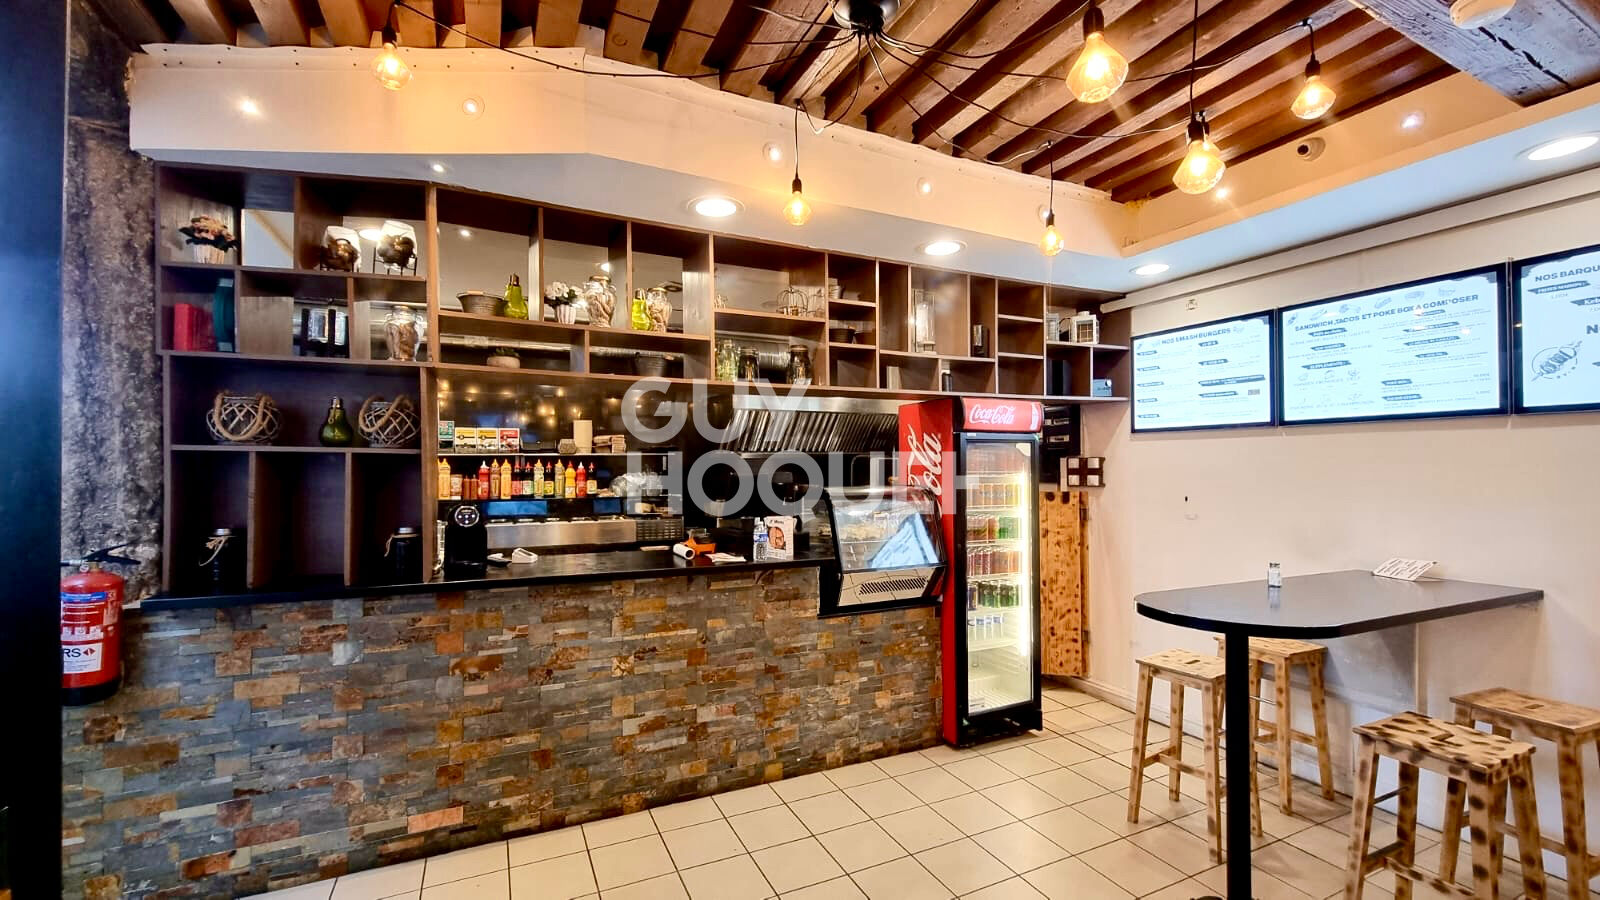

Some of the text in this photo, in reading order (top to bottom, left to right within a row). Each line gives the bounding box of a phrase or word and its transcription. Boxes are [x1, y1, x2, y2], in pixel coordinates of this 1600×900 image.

[1535, 273, 1558, 282] NOS
[1361, 312, 1372, 320] ET
[1373, 308, 1396, 318] POKE
[1397, 305, 1414, 314] BOX
[1422, 294, 1479, 309] COMPOSER
[1198, 327, 1231, 338] BURGERS
[969, 403, 1016, 425] Coca-Cola
